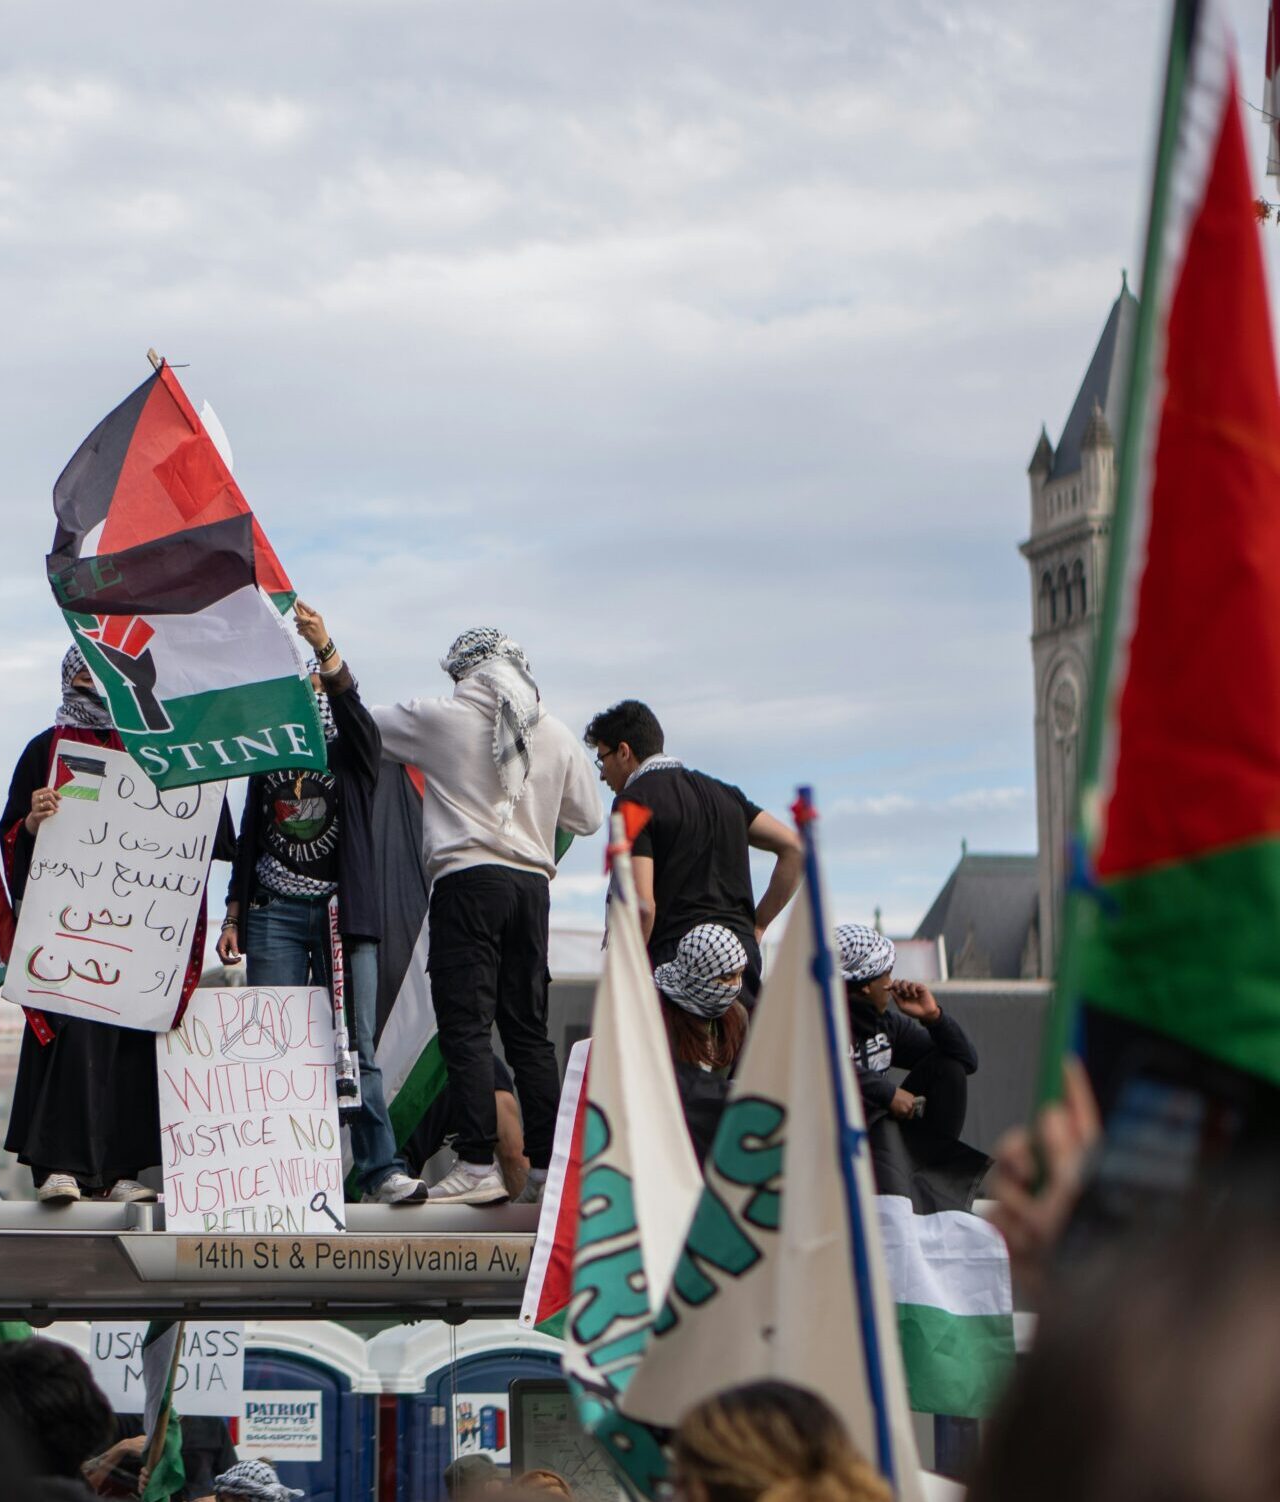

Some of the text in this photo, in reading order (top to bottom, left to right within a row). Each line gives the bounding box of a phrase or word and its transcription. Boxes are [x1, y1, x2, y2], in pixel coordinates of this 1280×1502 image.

[139, 723, 314, 776] STINE
[79, 822, 109, 845] لا
[58, 905, 132, 932] نحن
[24, 944, 121, 990] نحن
[165, 989, 324, 1061] NO PEACE
[164, 1063, 336, 1114] WITHOUT
[161, 1113, 335, 1168] JUSTICE NO
[163, 1156, 342, 1218] JUSTICE WITHOUT
[202, 1204, 306, 1232] RETURN
[195, 1242, 243, 1269] 14th
[253, 1242, 279, 1269] St
[289, 1242, 306, 1269] &
[315, 1242, 477, 1277] Pennsylvania
[95, 1331, 145, 1361] USA
[123, 1362, 228, 1393] MDIA
[245, 1402, 319, 1419] PATRIOT
[253, 1416, 309, 1425] POTTYS
